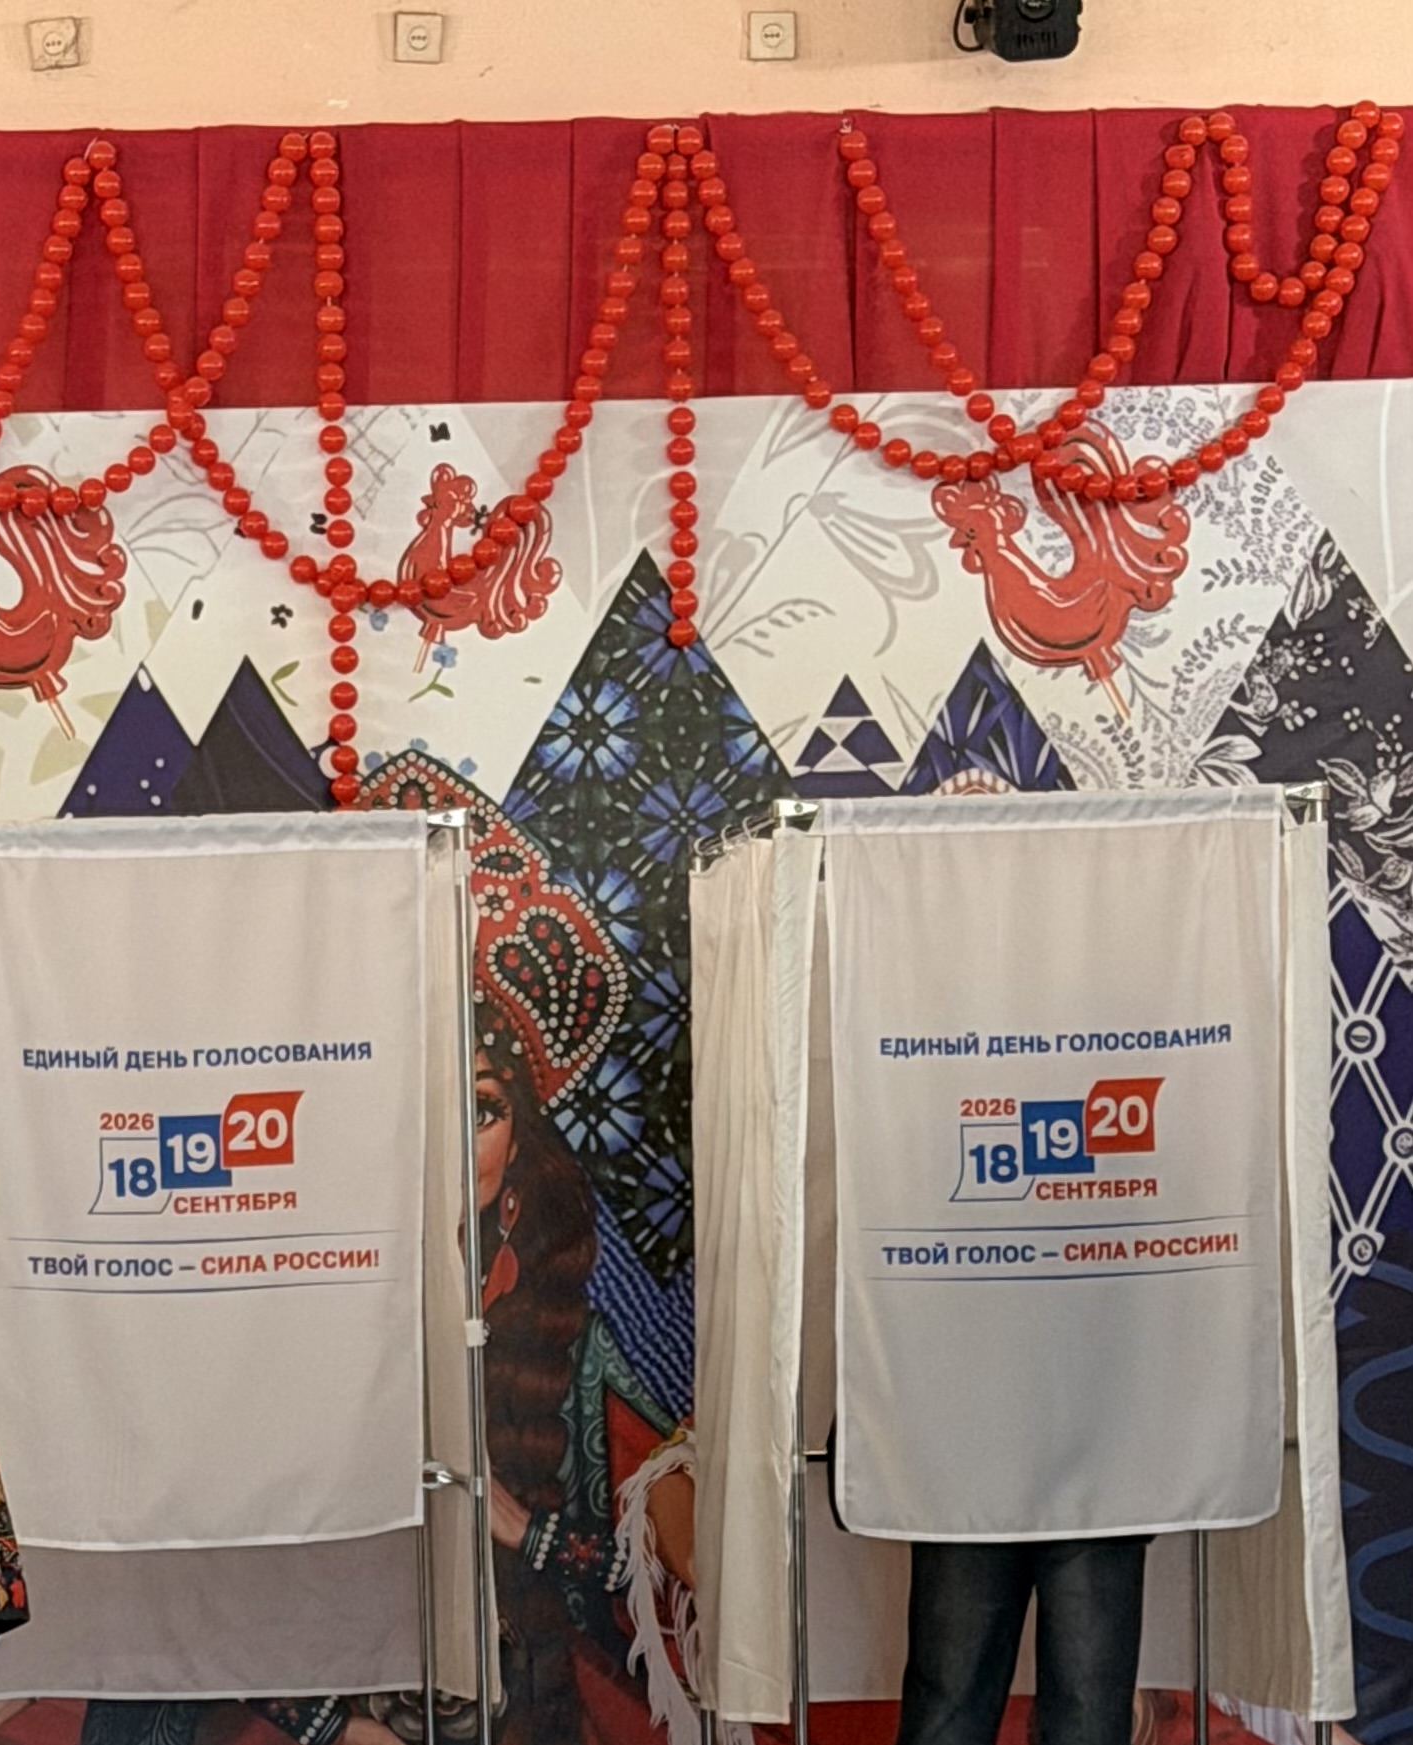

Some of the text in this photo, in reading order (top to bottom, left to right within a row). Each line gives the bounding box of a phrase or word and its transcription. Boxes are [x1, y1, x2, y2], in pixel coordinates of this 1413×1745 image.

[880, 1024, 1232, 1058] ЕДИНЫЙ ДЕНЬ ГОЛОСОВАНИЯ
[23, 1041, 372, 1072] ЕДИНЫЙ ДЕНЬ ГОЛОСОВАНИЯ
[99, 1112, 155, 1132] 2026
[960, 1098, 1017, 1118] 2026
[108, 1108, 288, 1198] 18 19 20
[968, 1095, 1148, 1184] 18 19 20
[173, 1191, 297, 1215] СЕНТЯБРЯ
[1035, 1178, 1158, 1201] СЕНТЯБРЯ
[28, 1254, 88, 1276] ТВОЙ
[94, 1256, 173, 1277] ГОЛОС
[200, 1255, 267, 1275] СИЛА
[273, 1249, 380, 1271] РОССИИ!
[882, 1242, 949, 1265] ТВОЙ
[955, 1244, 1036, 1264] ГОЛОС
[1063, 1242, 1128, 1262] СИЛА
[1134, 1233, 1239, 1259] РОССИИ!
